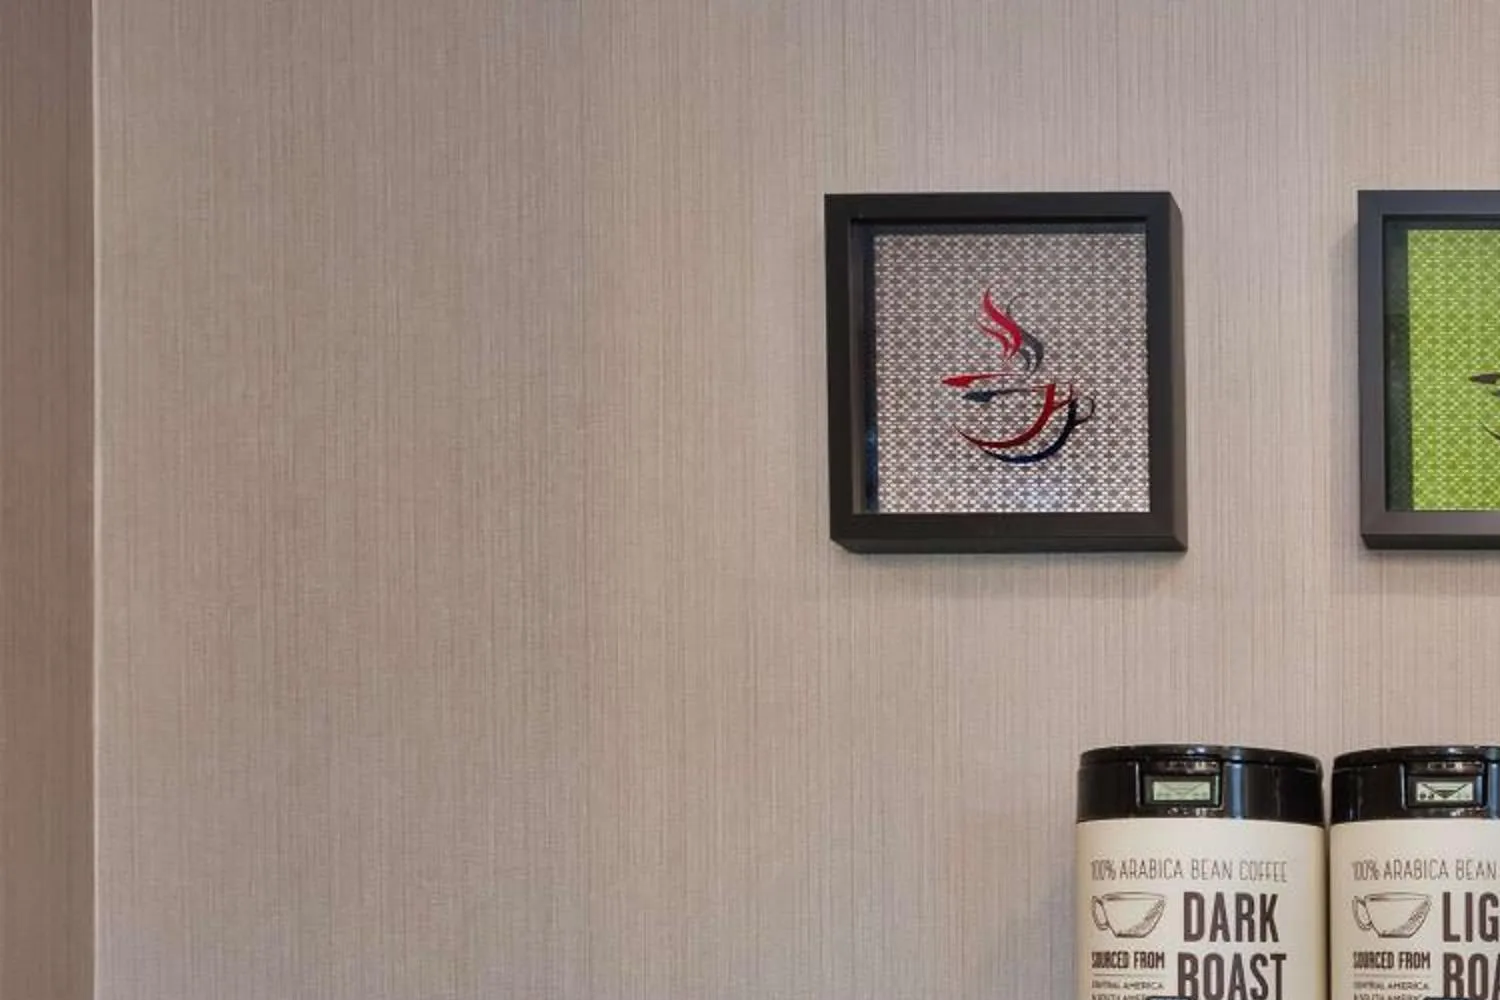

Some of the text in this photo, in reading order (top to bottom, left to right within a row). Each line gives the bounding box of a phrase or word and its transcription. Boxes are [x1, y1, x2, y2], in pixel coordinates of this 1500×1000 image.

[1091, 858, 1287, 883] 100% ARABICA BEAN COFFEE
[1352, 860, 1378, 881] 100%
[1384, 858, 1449, 881] ARABICA
[1456, 859, 1497, 881] BEAN
[1183, 891, 1279, 943] DARK
[1091, 951, 1165, 969] SOURCED FROM
[1353, 952, 1431, 969] SOURCED FROM
